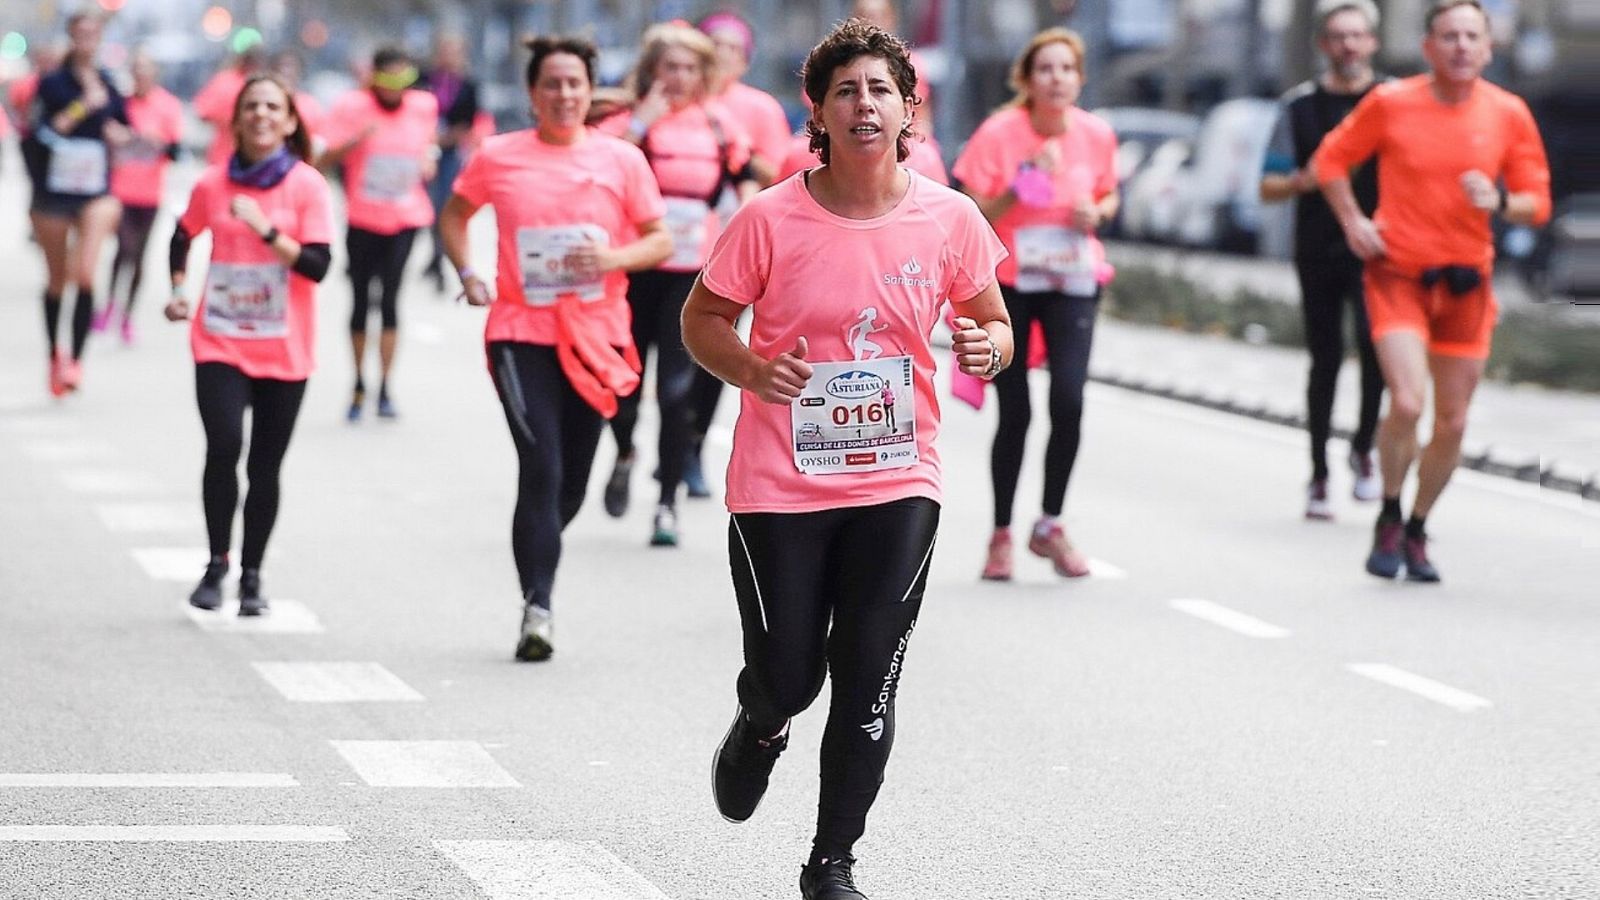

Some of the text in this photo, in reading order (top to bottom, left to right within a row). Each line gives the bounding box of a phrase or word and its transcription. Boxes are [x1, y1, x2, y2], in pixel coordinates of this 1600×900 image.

[884, 274, 935, 287] Santander
[832, 403, 883, 425] 016
[856, 428, 861, 438] 1
[833, 441, 846, 449] LES
[847, 440, 869, 448] DONES
[870, 439, 878, 447] DE
[879, 434, 913, 445] BARCELONA
[801, 456, 841, 466] OYSHO
[872, 619, 916, 714] Santander
